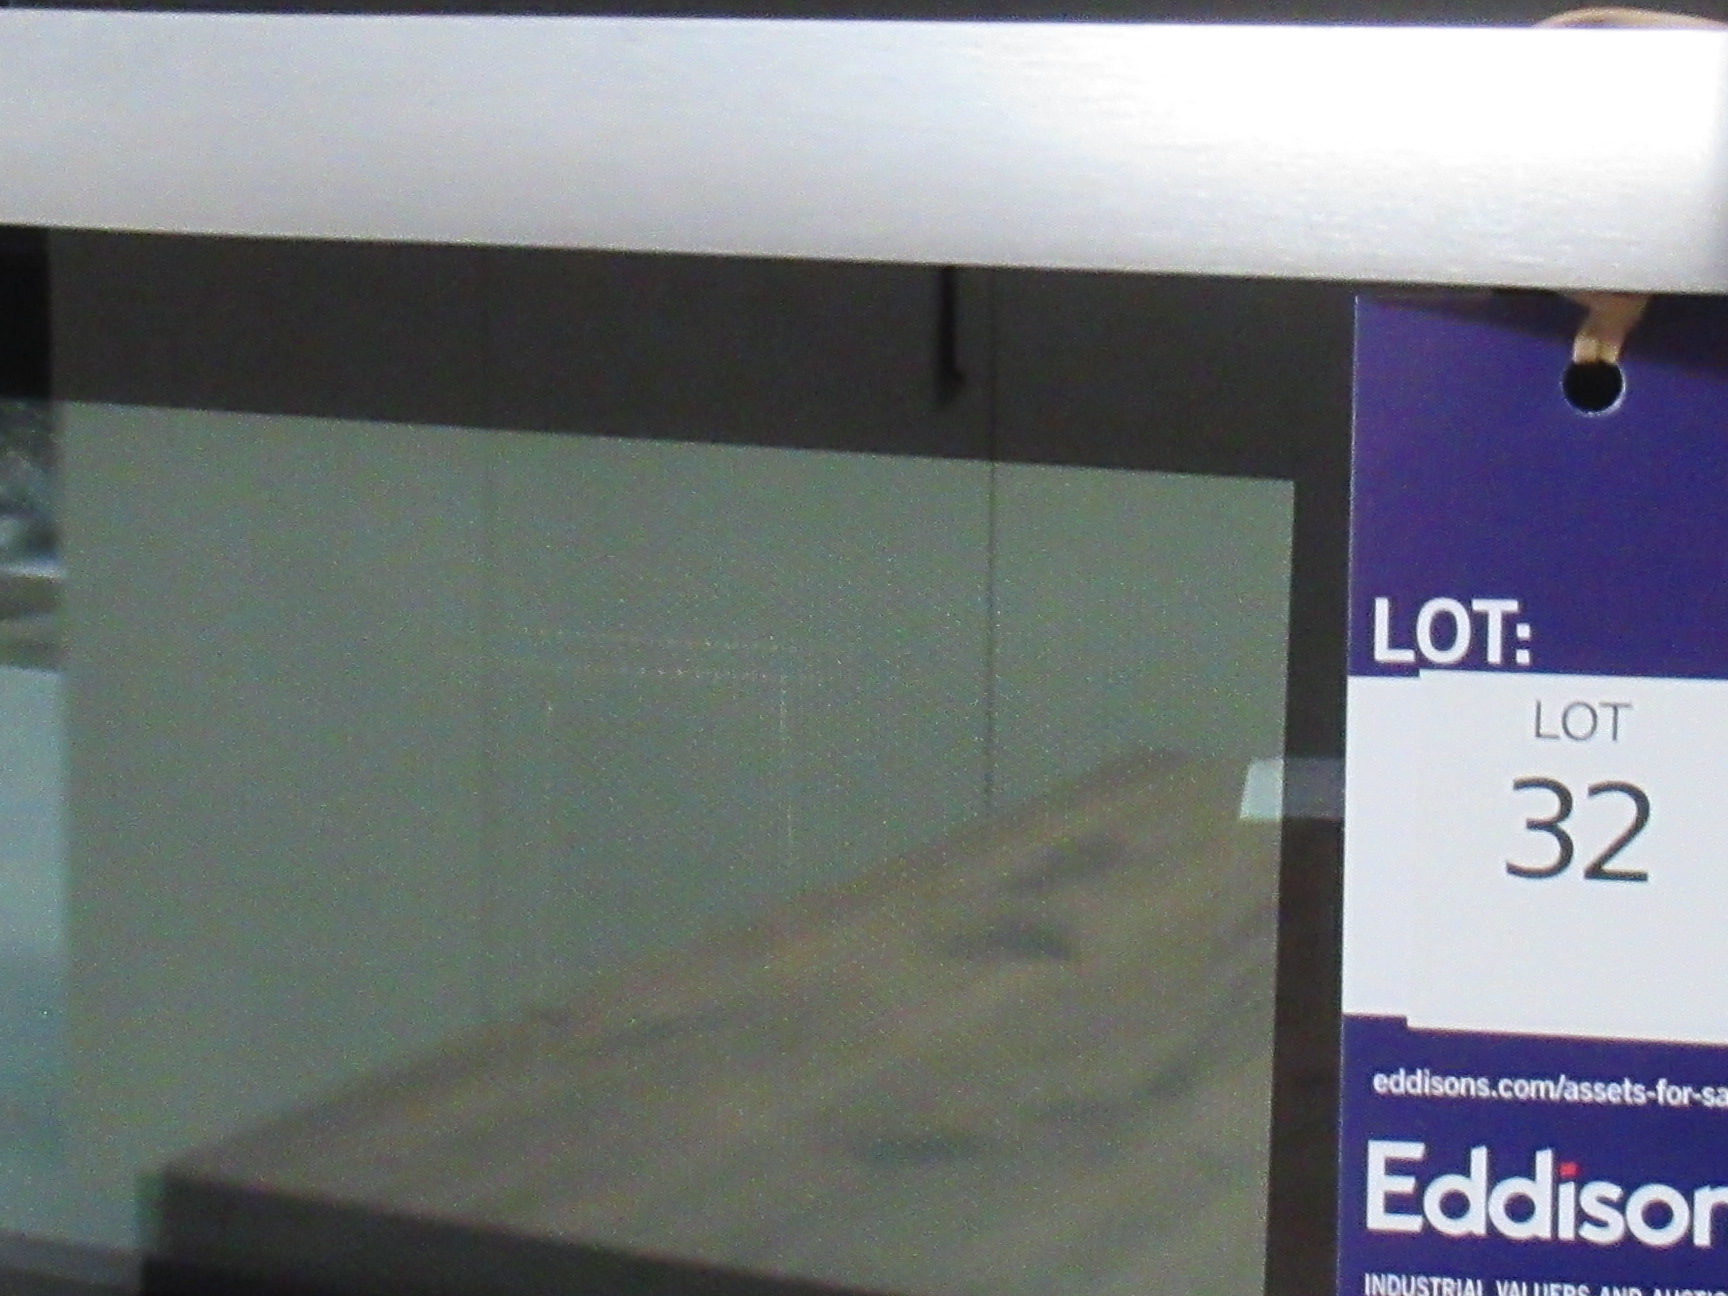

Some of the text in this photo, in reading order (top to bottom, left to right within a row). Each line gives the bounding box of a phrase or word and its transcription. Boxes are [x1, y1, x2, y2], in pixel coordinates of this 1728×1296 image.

[1373, 597, 1532, 666] LOT:
[1534, 699, 1632, 743] LOT
[1504, 777, 1651, 884] 32
